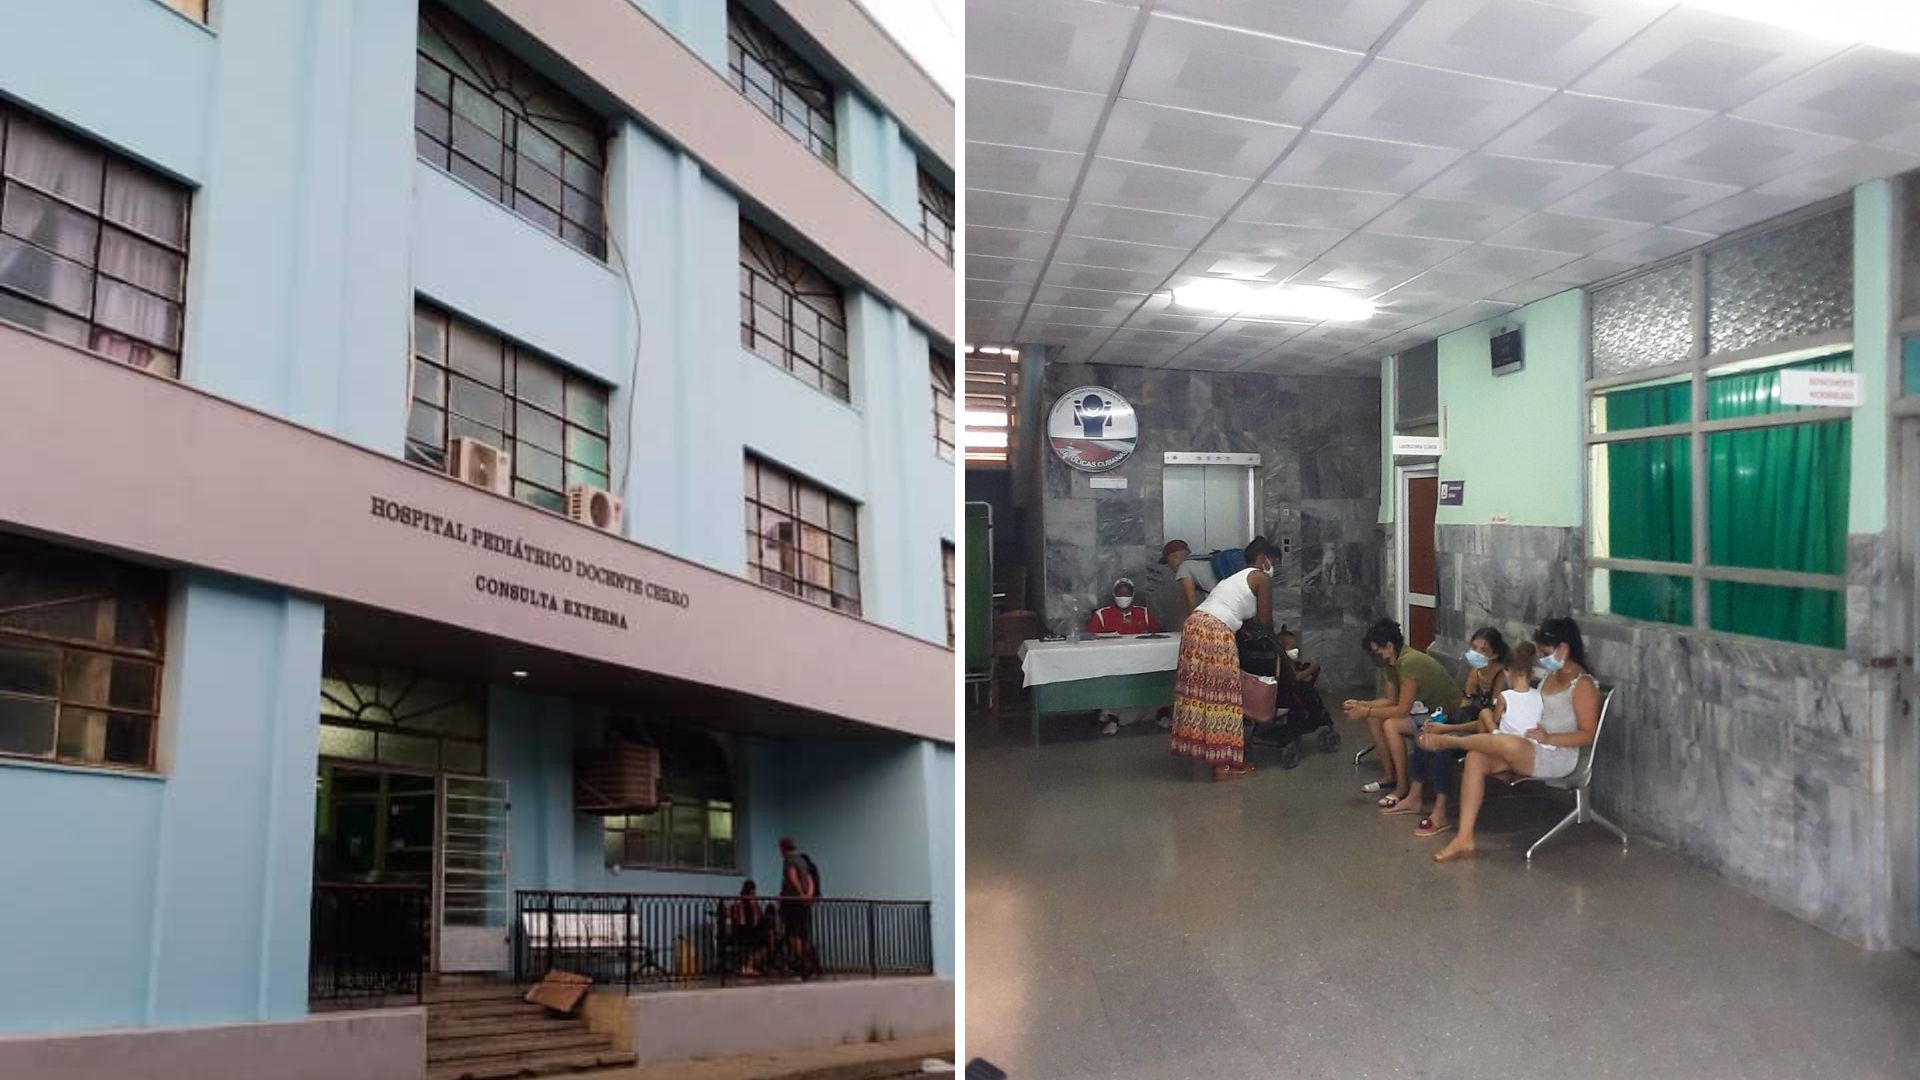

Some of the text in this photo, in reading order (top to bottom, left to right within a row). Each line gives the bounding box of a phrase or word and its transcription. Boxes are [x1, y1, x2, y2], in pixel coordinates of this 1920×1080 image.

[371, 496, 690, 609] HOSPITAL PEDIÁTRICO DOCENTE CERRO
[476, 575, 628, 629] CONSULTA EXTERNA
